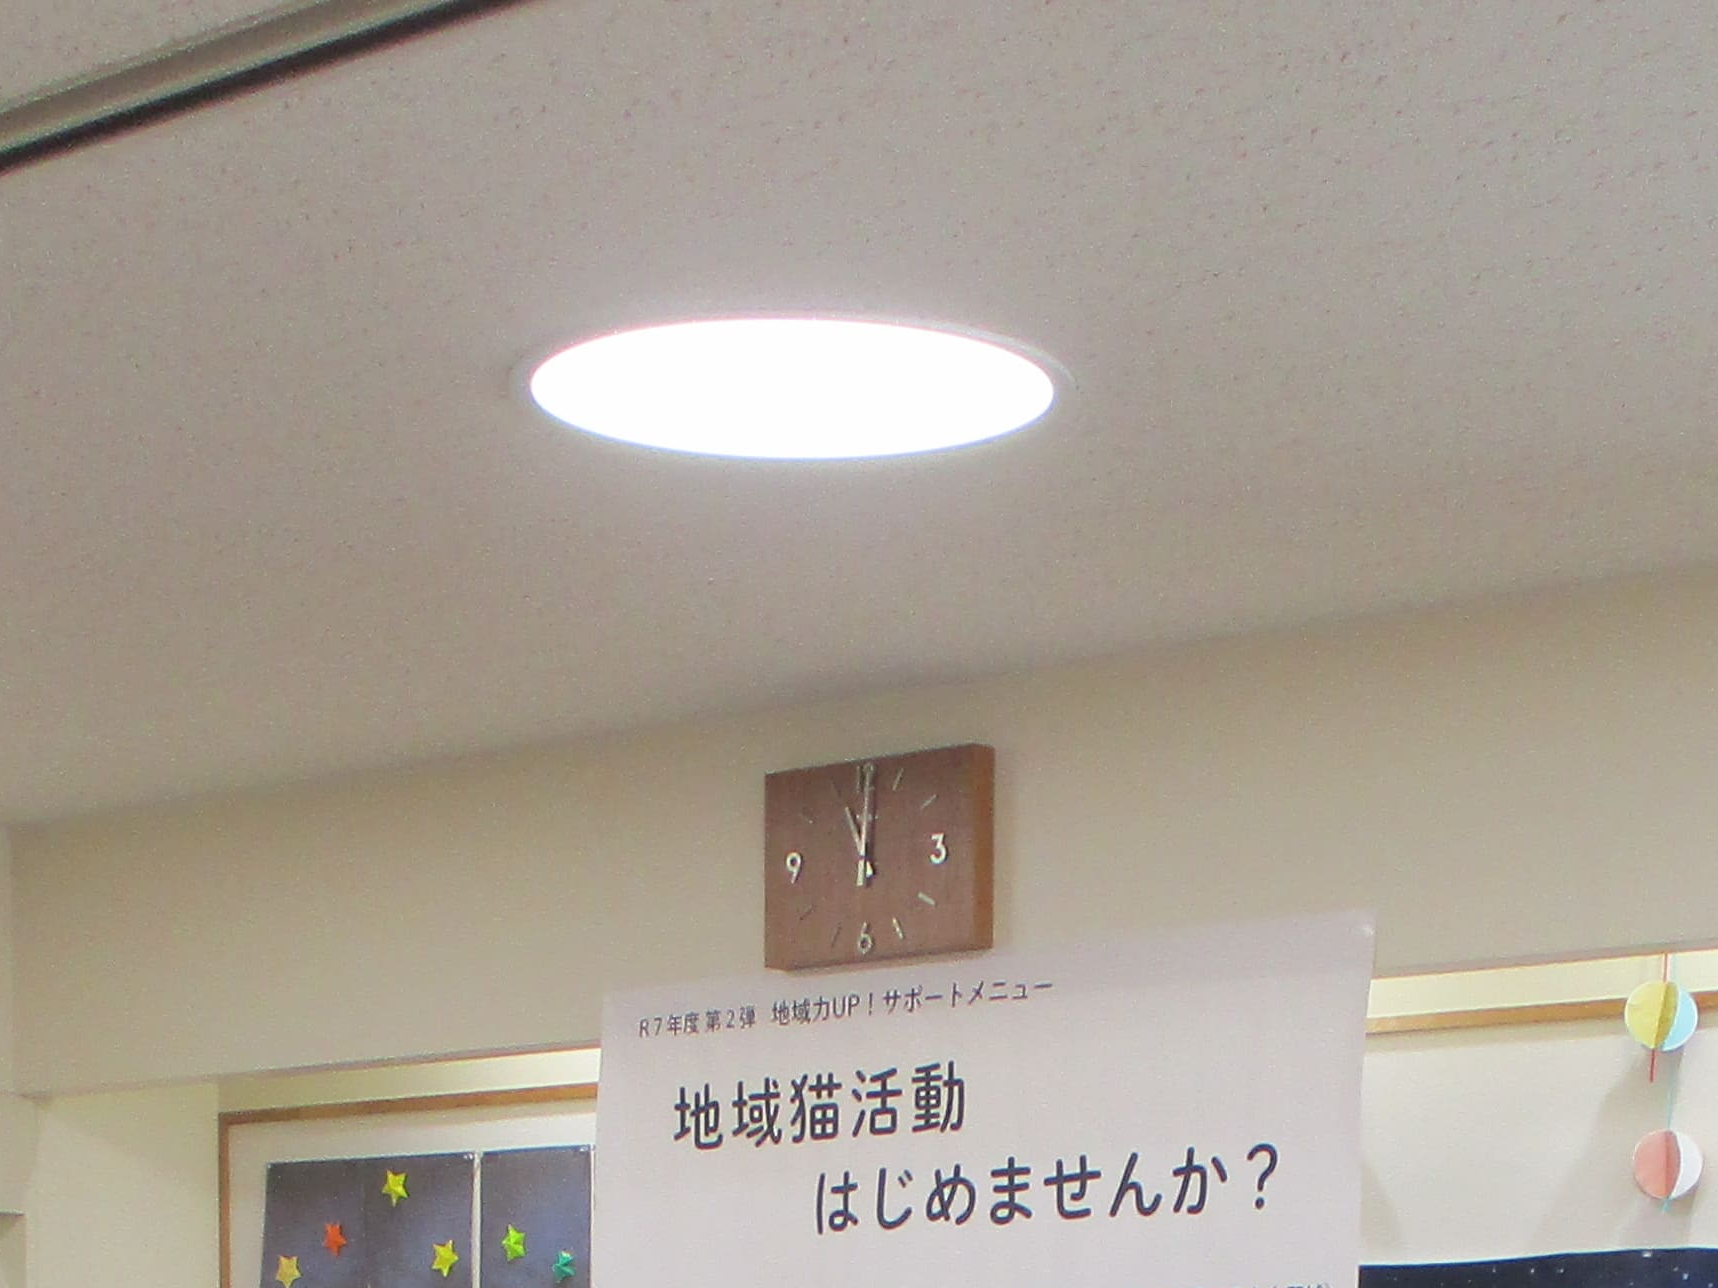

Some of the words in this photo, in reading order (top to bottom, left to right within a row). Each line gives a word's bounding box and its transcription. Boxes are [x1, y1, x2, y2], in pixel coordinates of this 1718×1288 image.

[929, 832, 948, 865] 3
[785, 851, 803, 884] 9
[856, 921, 873, 956] 6
[638, 1004, 757, 1038] R7年度第2弾
[672, 1059, 966, 1150] 地域猫活動
[815, 1142, 1280, 1236] はじめませんか？
